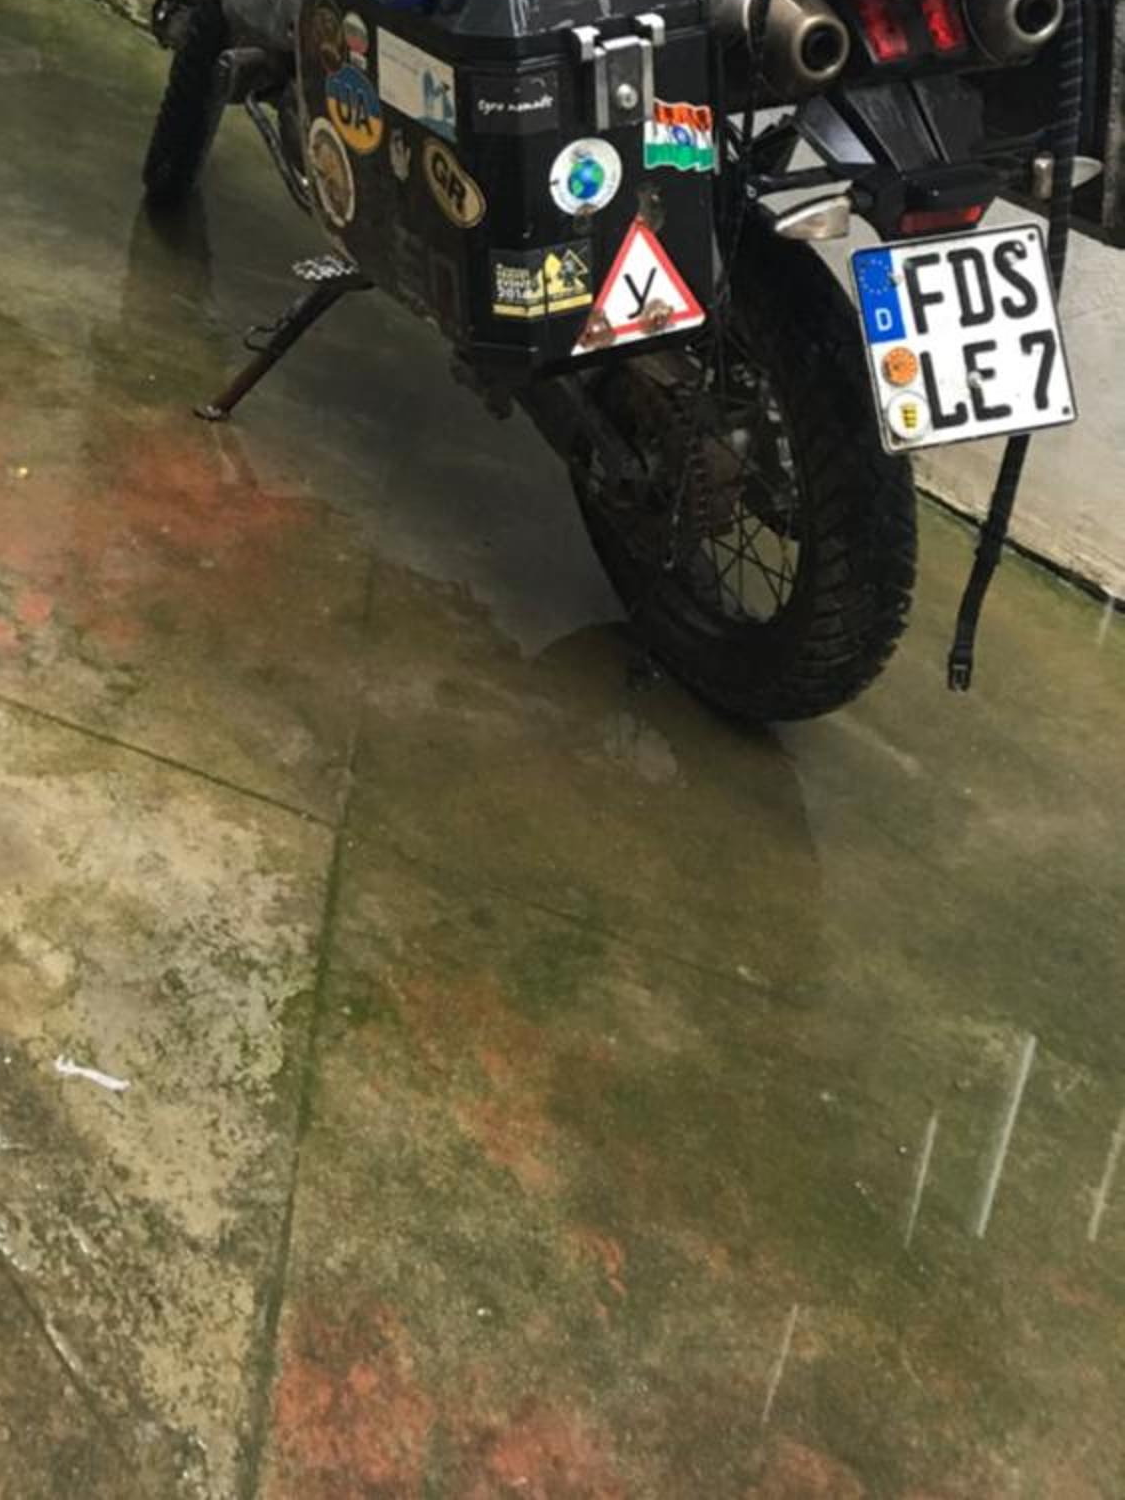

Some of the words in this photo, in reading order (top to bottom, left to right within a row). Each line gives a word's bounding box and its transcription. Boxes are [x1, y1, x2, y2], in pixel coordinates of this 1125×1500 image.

[432, 152, 466, 214] GR
[875, 308, 892, 332] D
[904, 240, 1038, 334] FDS
[920, 339, 1012, 430] LE
[1019, 328, 1057, 411] 7
